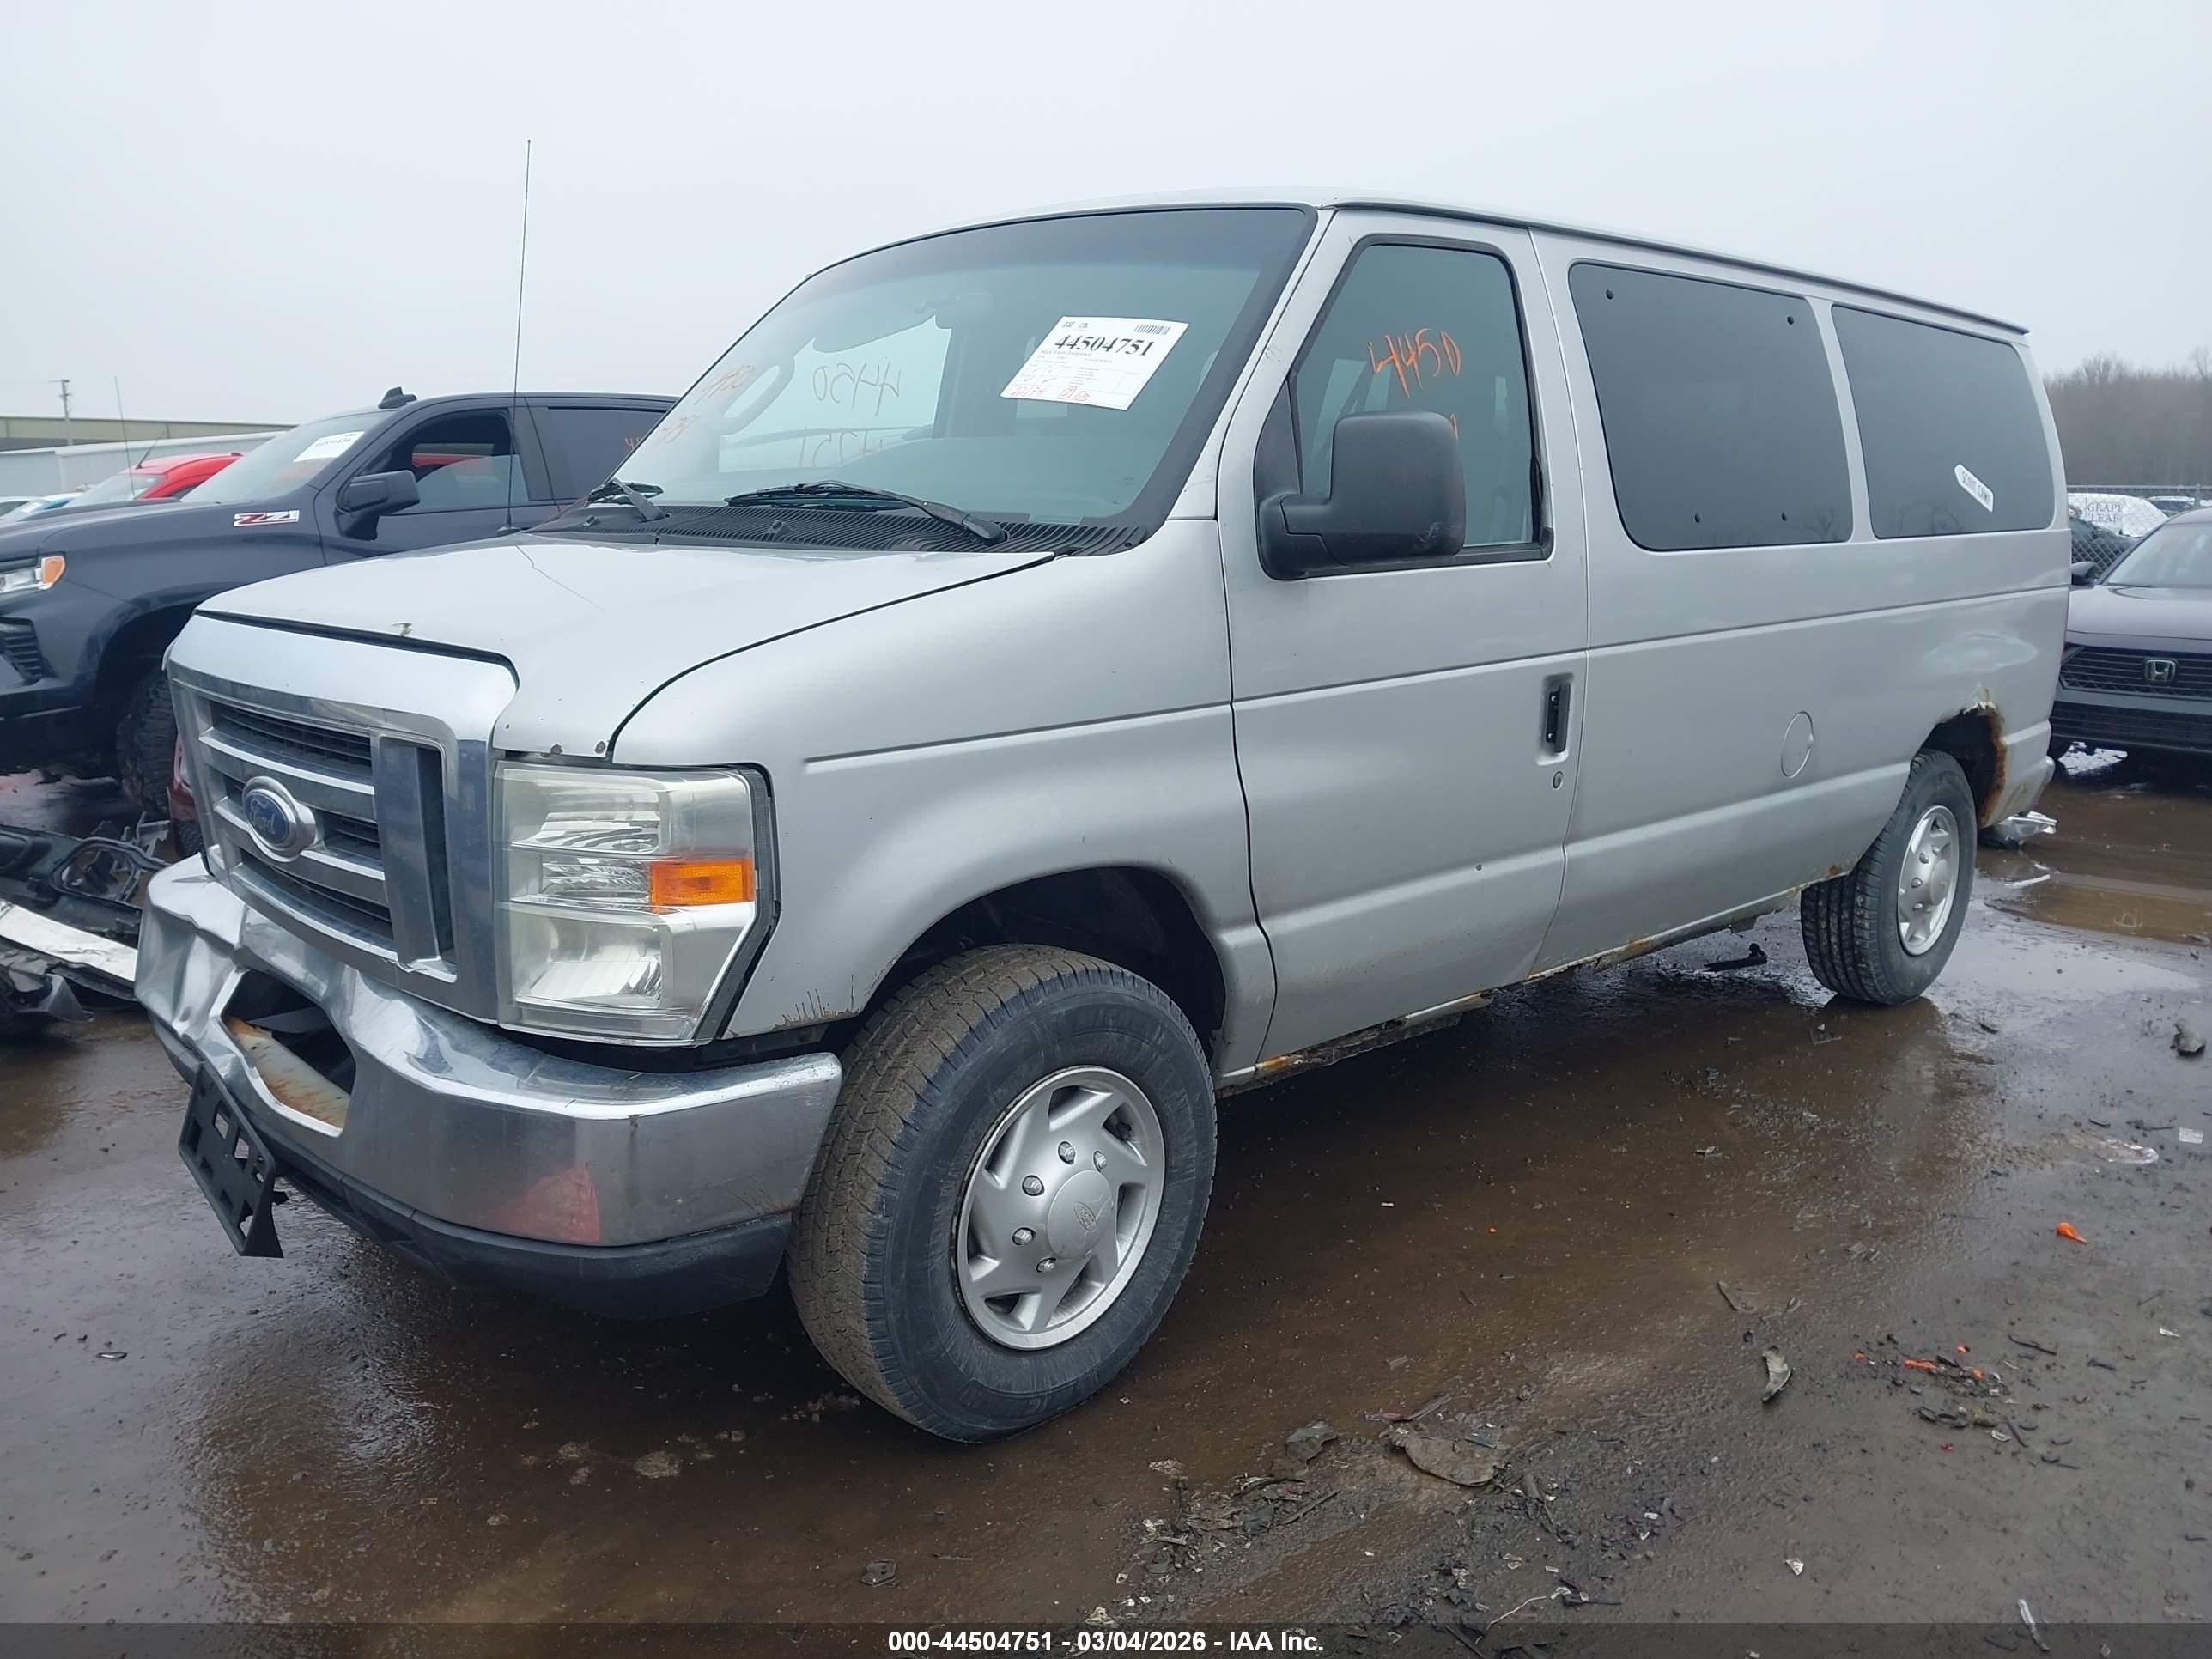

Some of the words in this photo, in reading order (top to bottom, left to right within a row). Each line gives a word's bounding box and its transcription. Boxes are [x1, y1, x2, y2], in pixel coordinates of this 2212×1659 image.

[1054, 334, 1155, 357] 44504751
[1367, 327, 1462, 398] 4450
[248, 797, 276, 835] Ford
